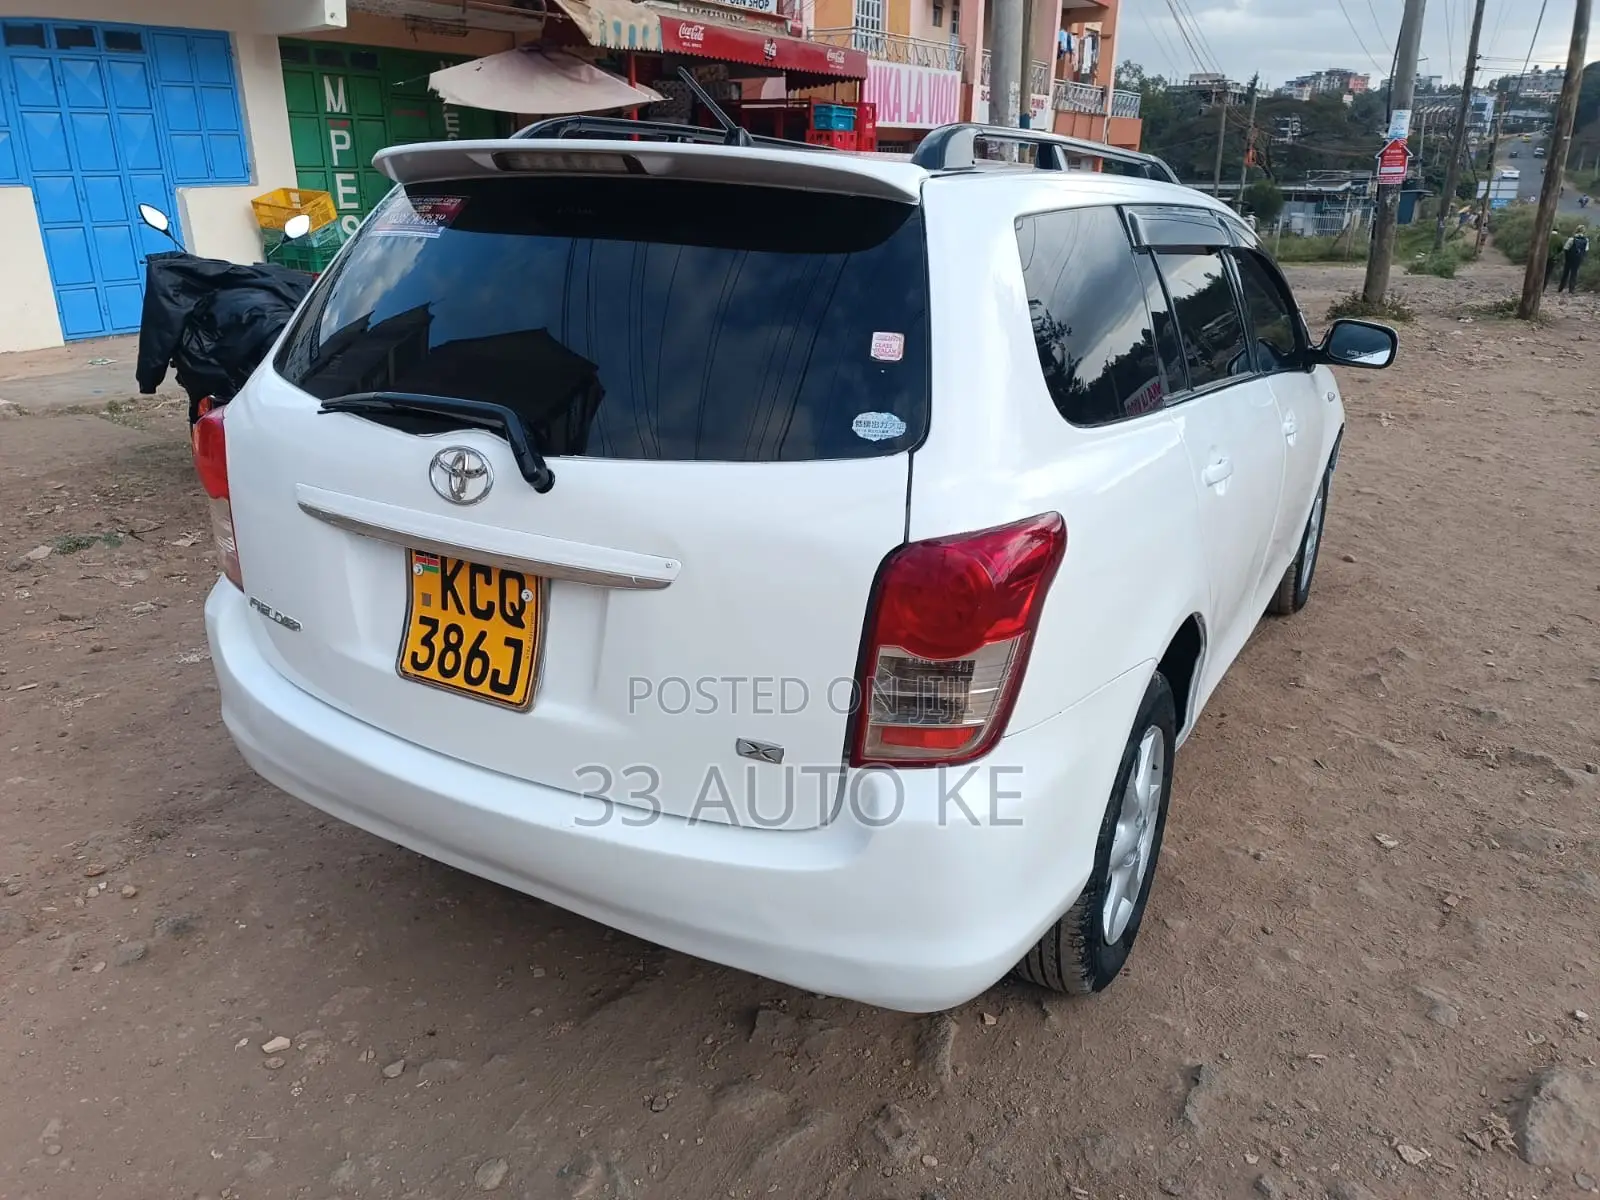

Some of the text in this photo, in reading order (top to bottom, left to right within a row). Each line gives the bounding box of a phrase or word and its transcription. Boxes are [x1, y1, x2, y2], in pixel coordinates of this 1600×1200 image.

[749, 0, 770, 10] SHOP
[907, 69, 923, 123] LA
[250, 596, 302, 632] FIELDER
[440, 555, 526, 629] KCQ
[410, 615, 524, 696] 386J
